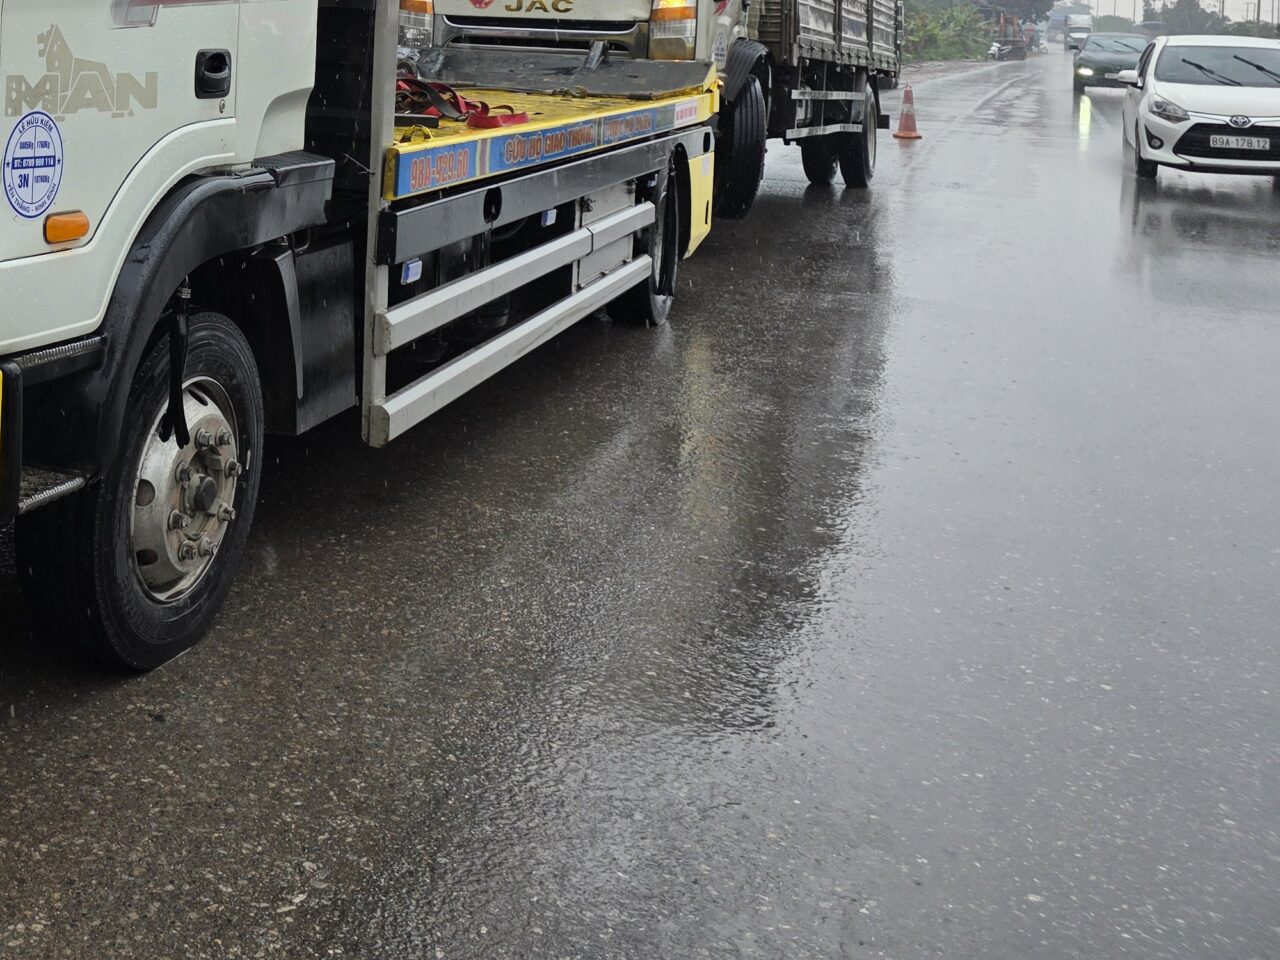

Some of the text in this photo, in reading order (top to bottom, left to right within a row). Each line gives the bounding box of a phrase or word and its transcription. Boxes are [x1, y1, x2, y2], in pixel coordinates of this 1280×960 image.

[4, 70, 159, 118] MAN
[504, 135, 528, 165] CỨU
[528, 132, 543, 162] HỘ
[544, 130, 567, 156] GIAO
[17, 173, 30, 189] 3N
[410, 148, 470, 192] 98A-929.60
